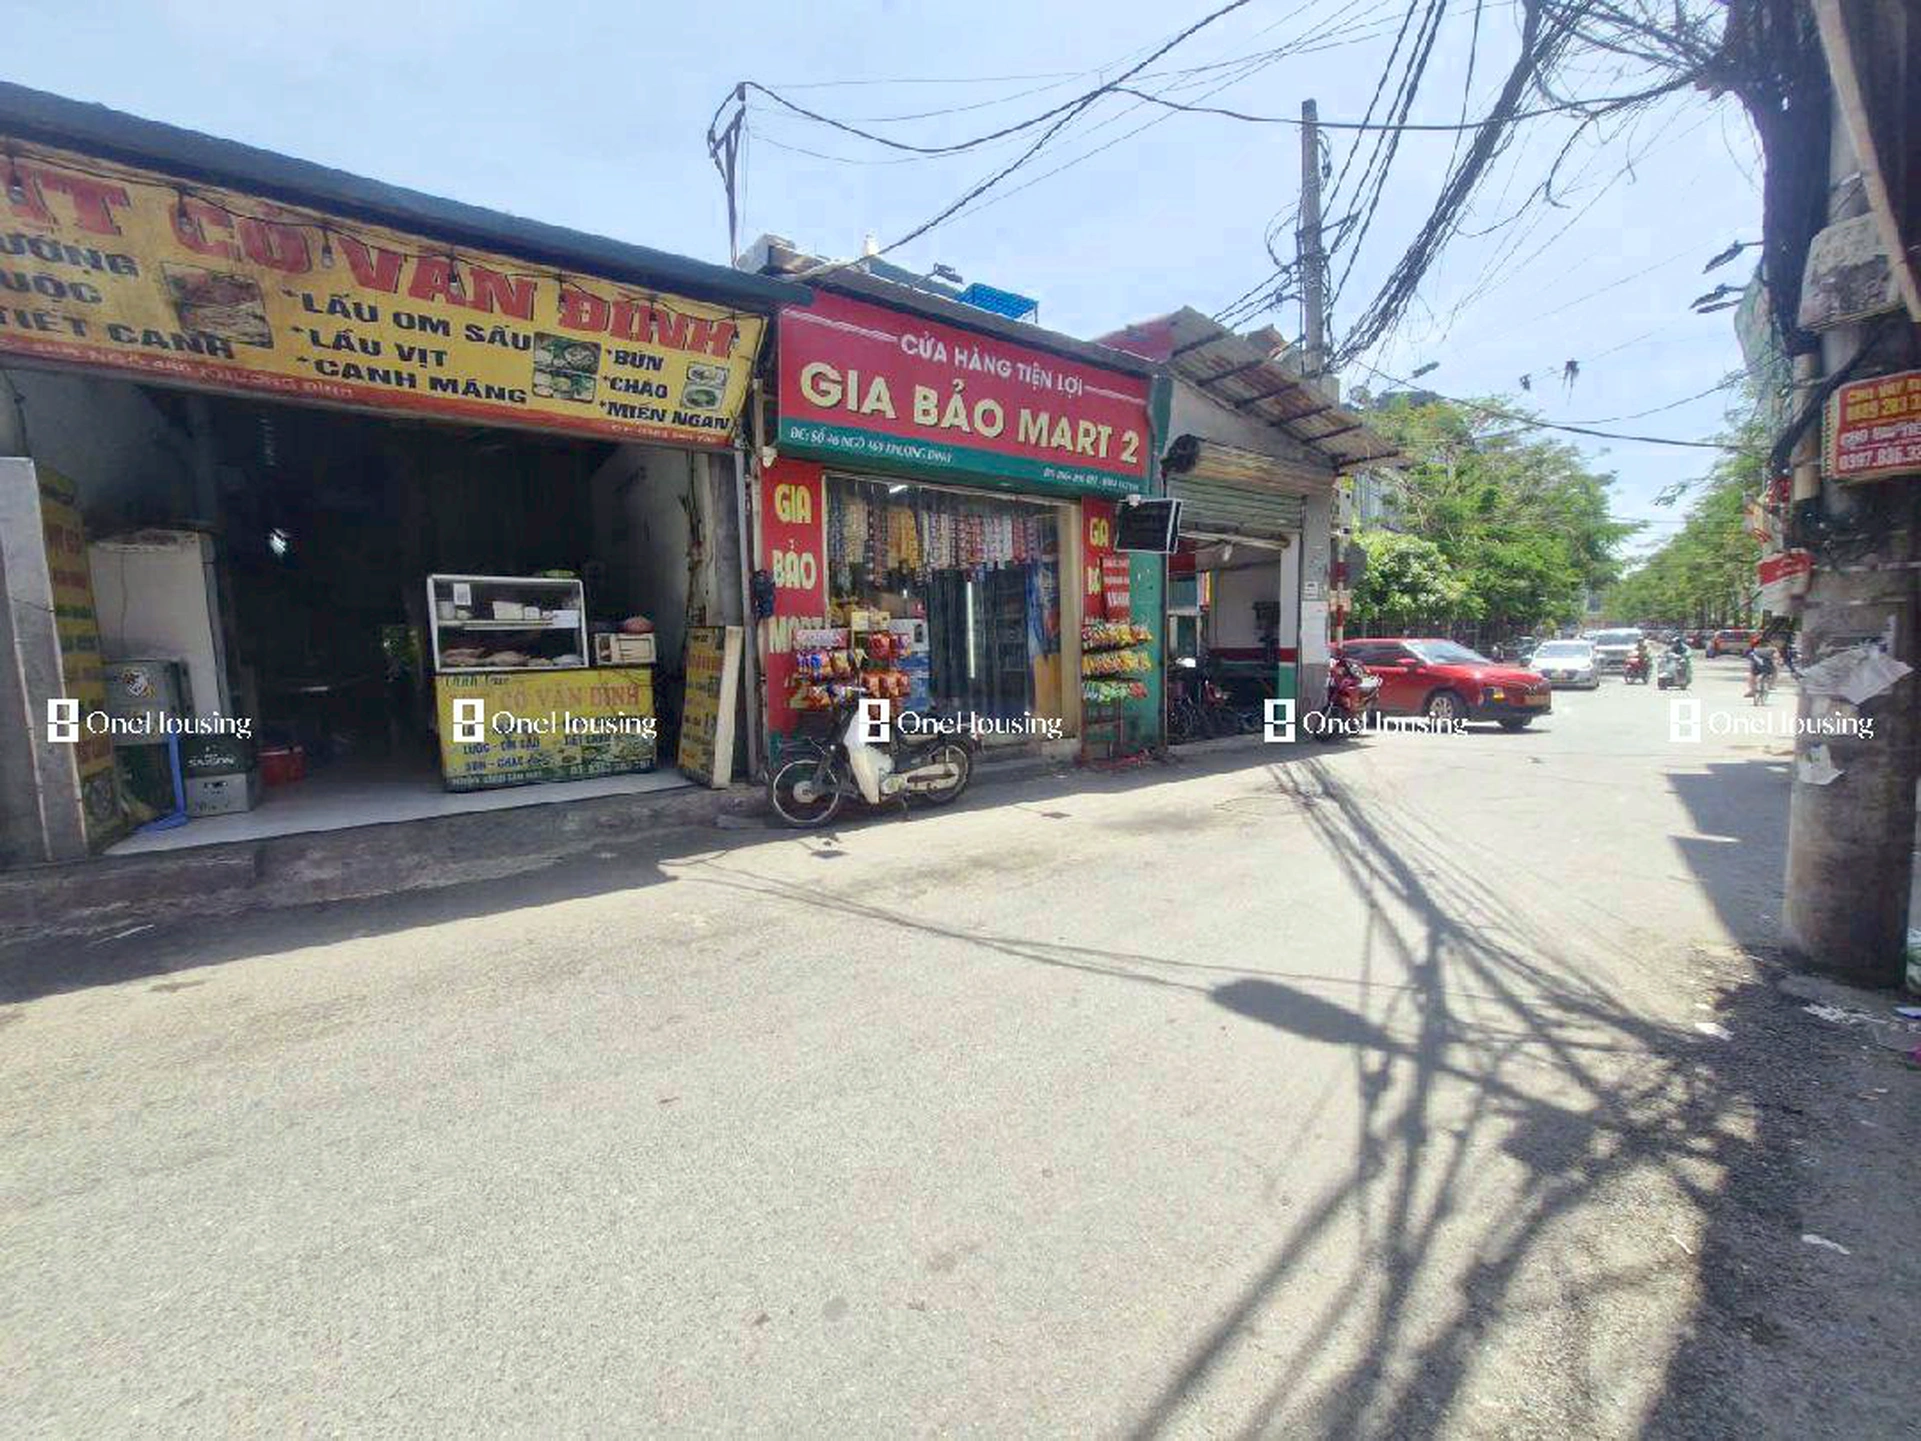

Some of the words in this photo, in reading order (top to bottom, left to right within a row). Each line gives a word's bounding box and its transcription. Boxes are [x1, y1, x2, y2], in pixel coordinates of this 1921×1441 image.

[107, 322, 235, 359] CANH
[393, 311, 450, 336] OM
[314, 358, 416, 388] CANH
[395, 343, 447, 368] VỊT
[901, 331, 947, 362] CỬA
[954, 346, 1013, 378] HÀNG
[1016, 362, 1052, 391] TIỆN
[1057, 376, 1083, 398] LỢI
[672, 410, 730, 430] NGAN
[800, 361, 897, 420] GIA
[912, 379, 1005, 439] BẢO
[1017, 408, 1116, 460] MART
[1120, 430, 1141, 464] 2
[774, 483, 812, 524] GIA
[773, 539, 817, 590] BẢO
